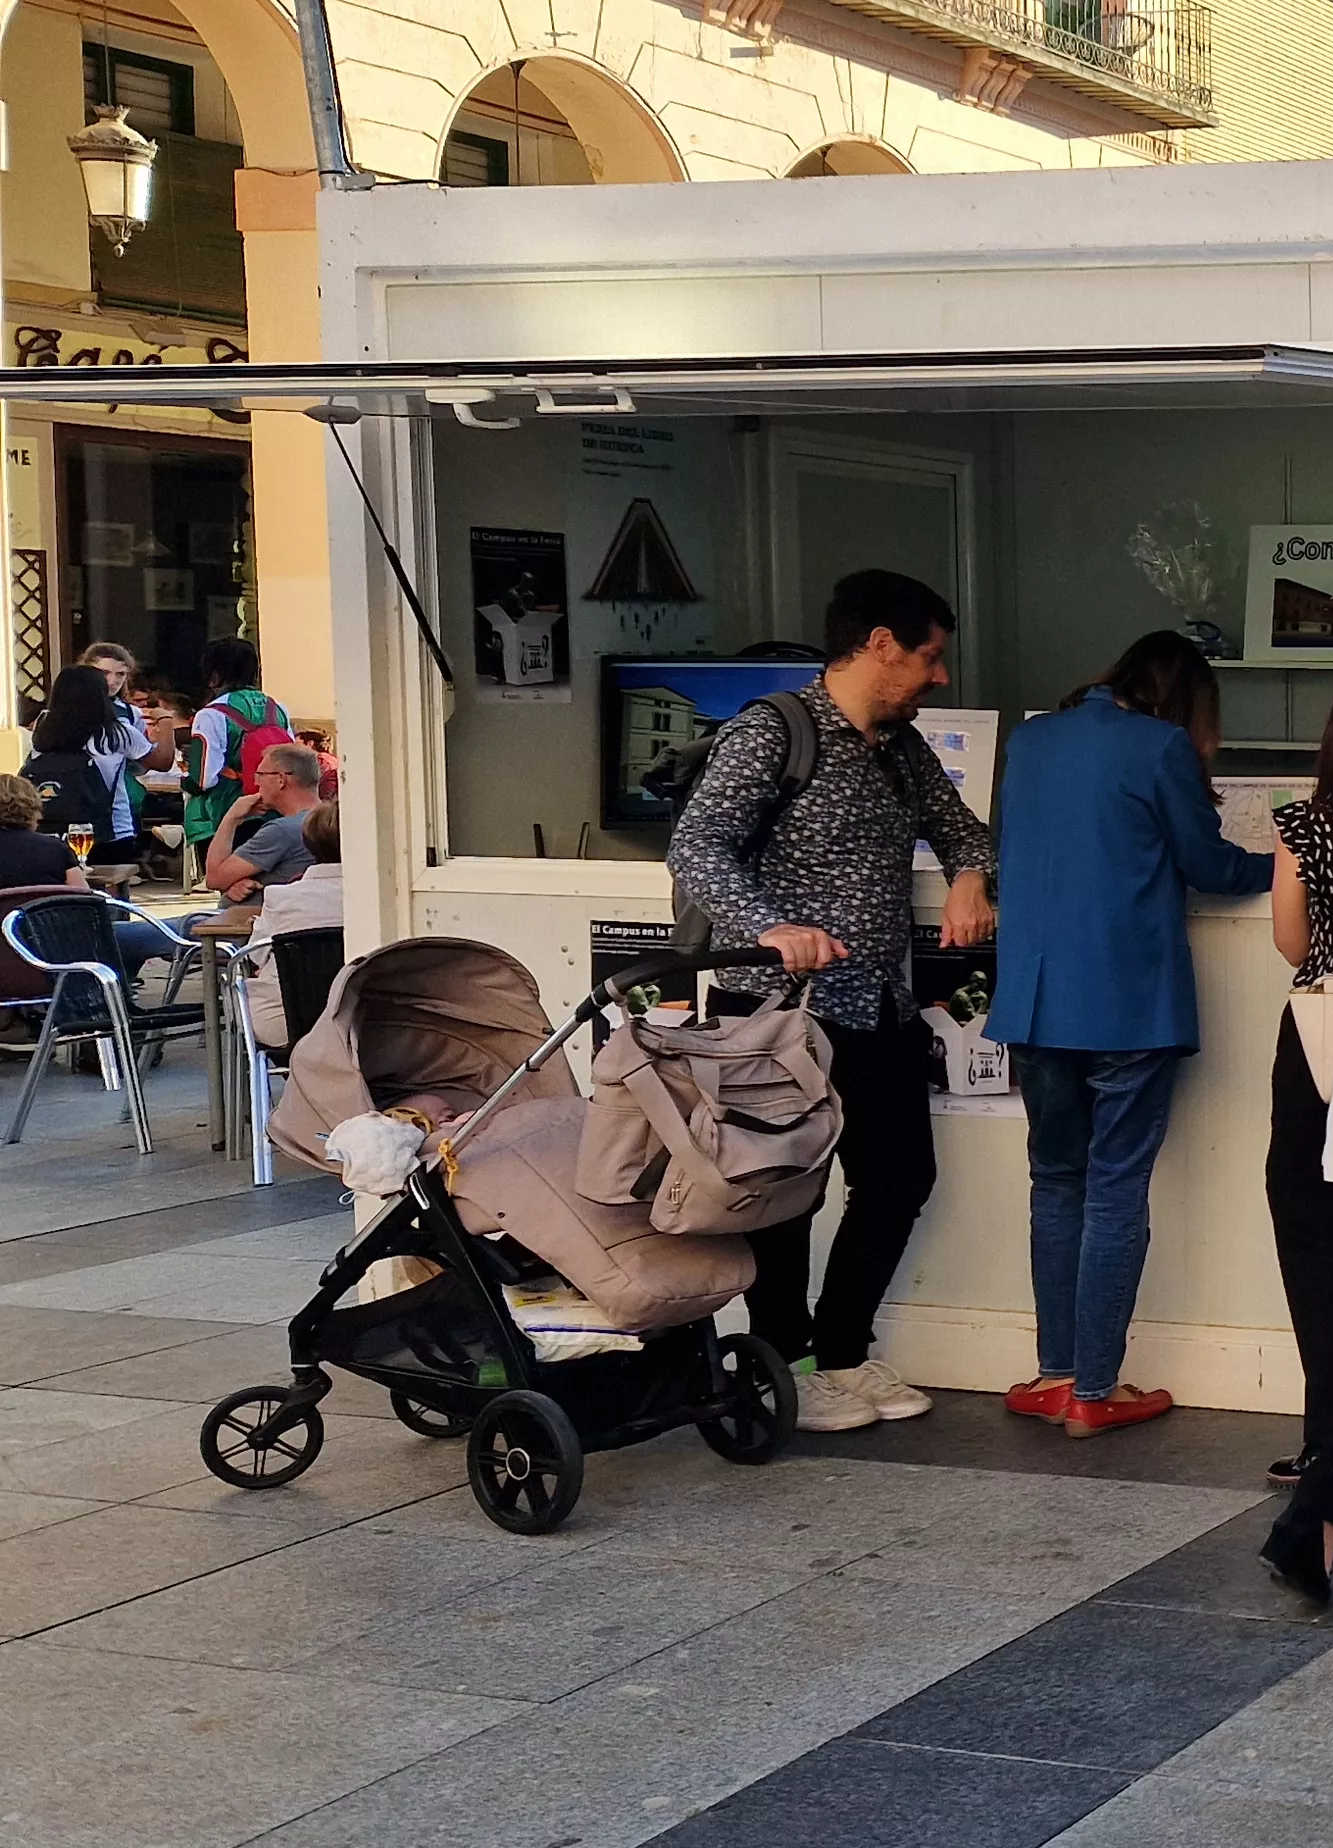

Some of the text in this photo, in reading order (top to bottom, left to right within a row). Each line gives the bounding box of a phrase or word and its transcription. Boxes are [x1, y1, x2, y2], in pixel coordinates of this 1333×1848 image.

[592, 925, 601, 934] El
[602, 925, 641, 937] Campus
[642, 928, 655, 937] en
[656, 926, 667, 937] la
